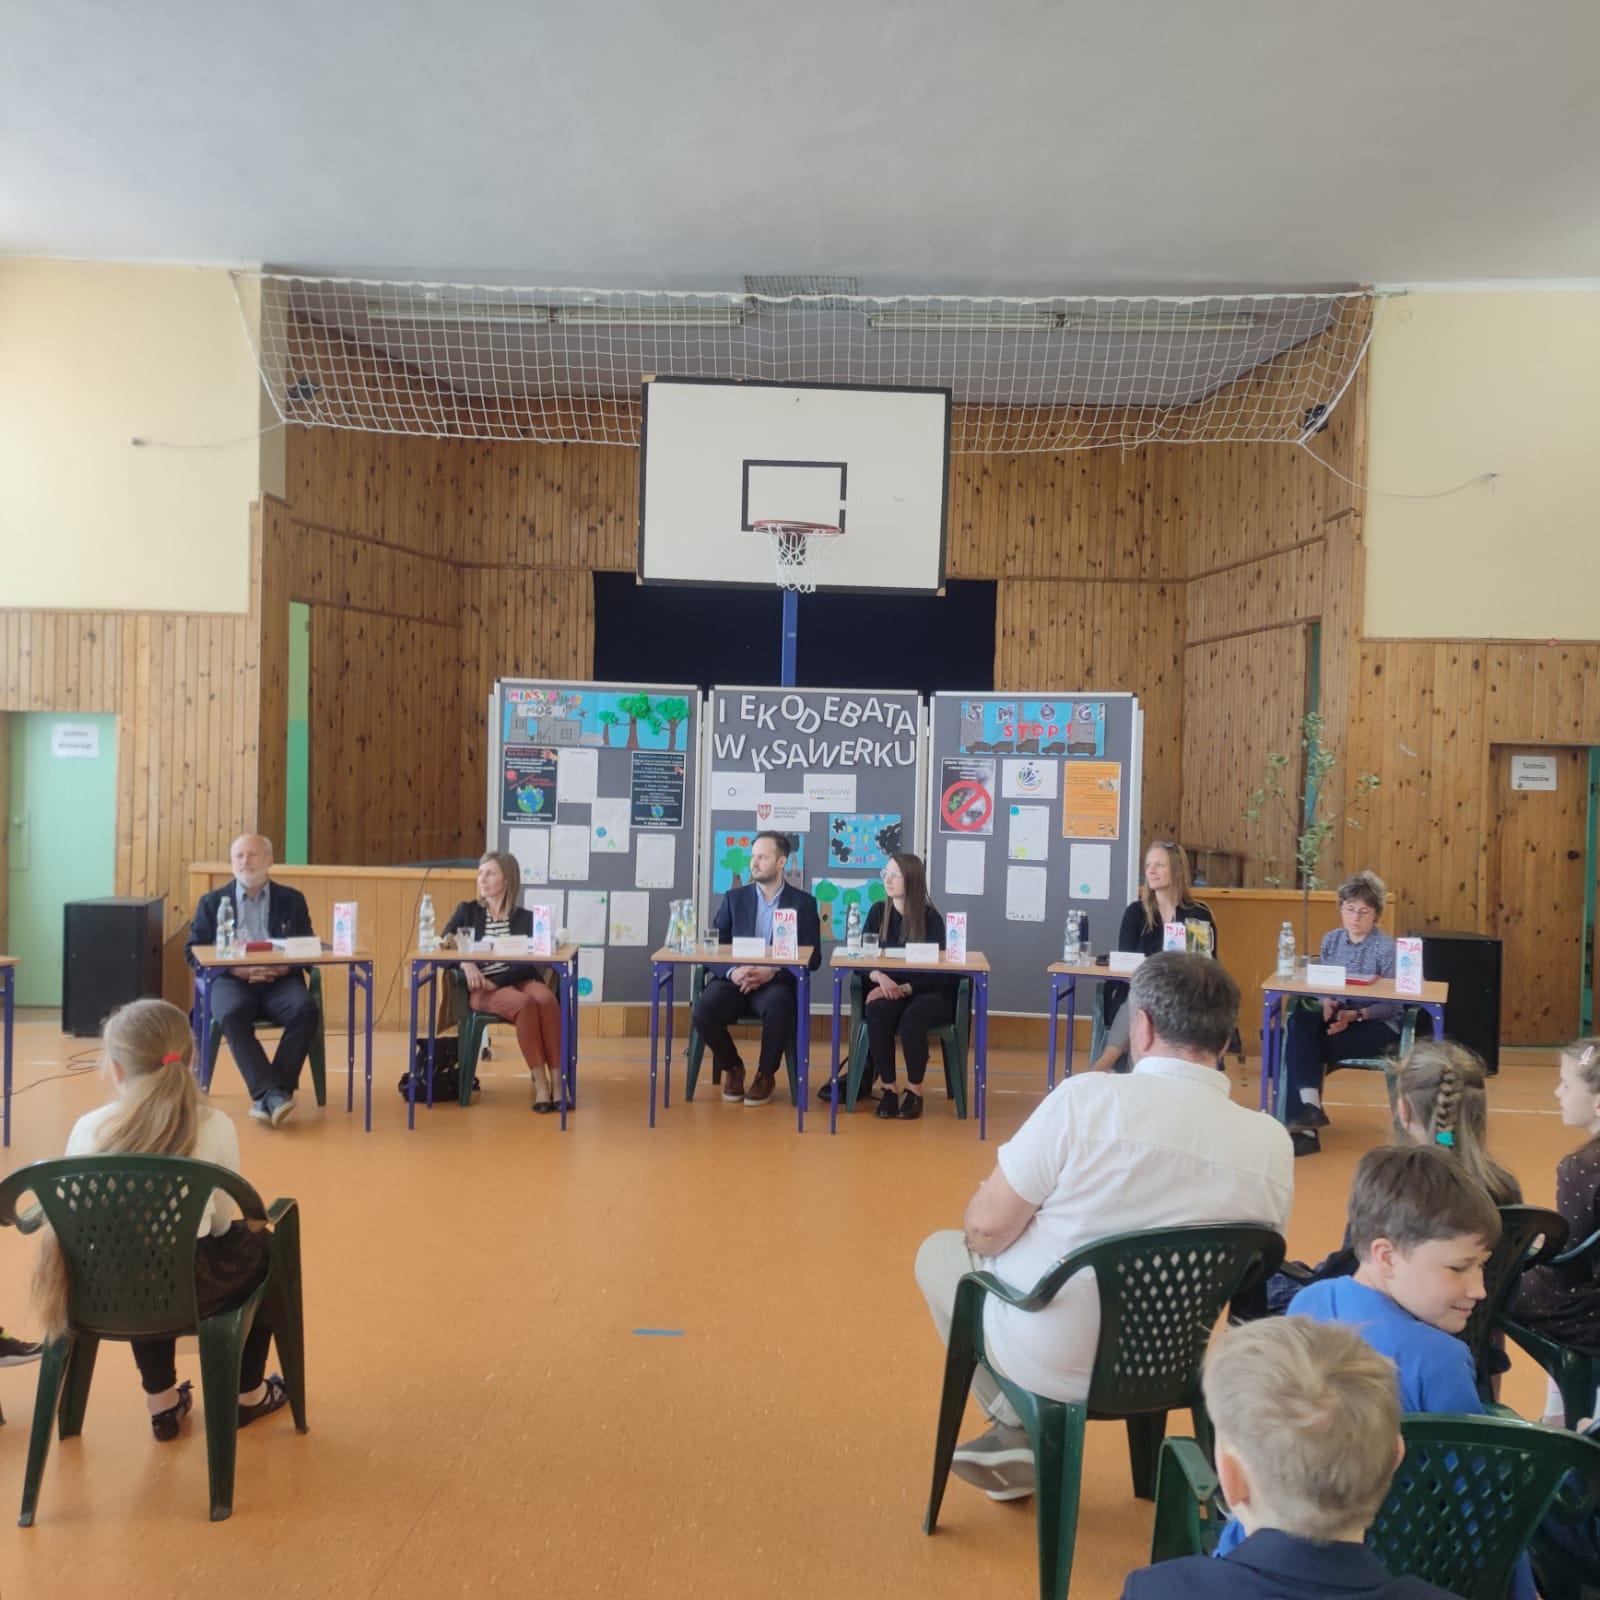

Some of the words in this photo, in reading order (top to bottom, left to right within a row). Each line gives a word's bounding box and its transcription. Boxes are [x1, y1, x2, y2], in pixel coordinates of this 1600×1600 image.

[719, 698, 726, 723] I
[740, 694, 916, 736] EKODEBATA
[713, 733, 746, 760] W
[751, 737, 916, 773] KSAWERKU
